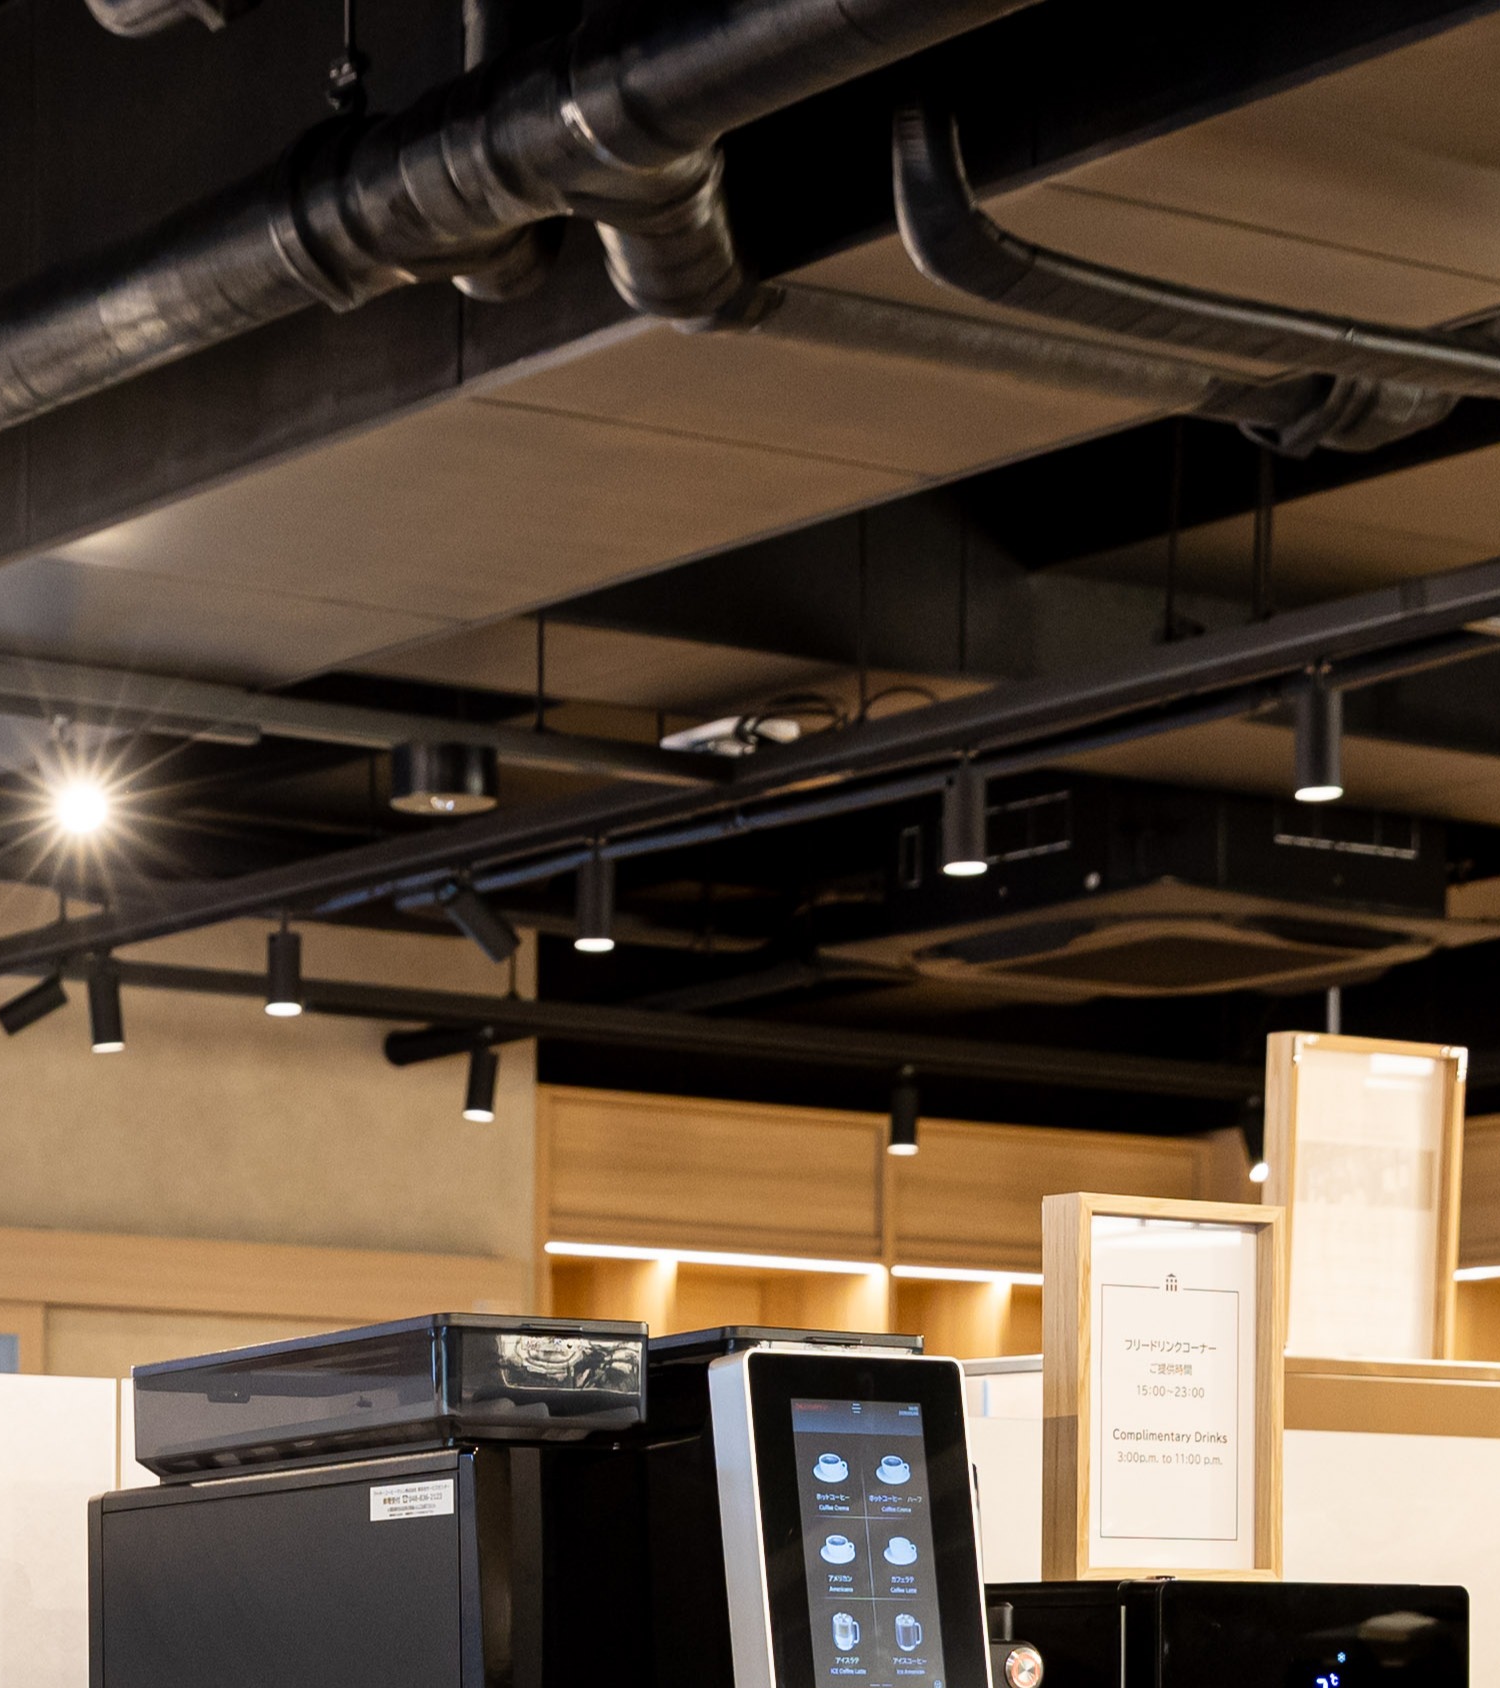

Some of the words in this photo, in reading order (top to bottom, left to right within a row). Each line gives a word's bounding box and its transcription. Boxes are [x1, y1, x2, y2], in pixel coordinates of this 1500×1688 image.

[1124, 1338, 1217, 1354] フリードリンクコーナー
[1149, 1363, 1193, 1376] ご提供時間
[1112, 1428, 1191, 1443] Complimentary
[1194, 1431, 1228, 1444] Drinks
[1162, 1453, 1172, 1463] to
[1175, 1453, 1200, 1465] 11:00
[1204, 1455, 1223, 1466] p.m.
